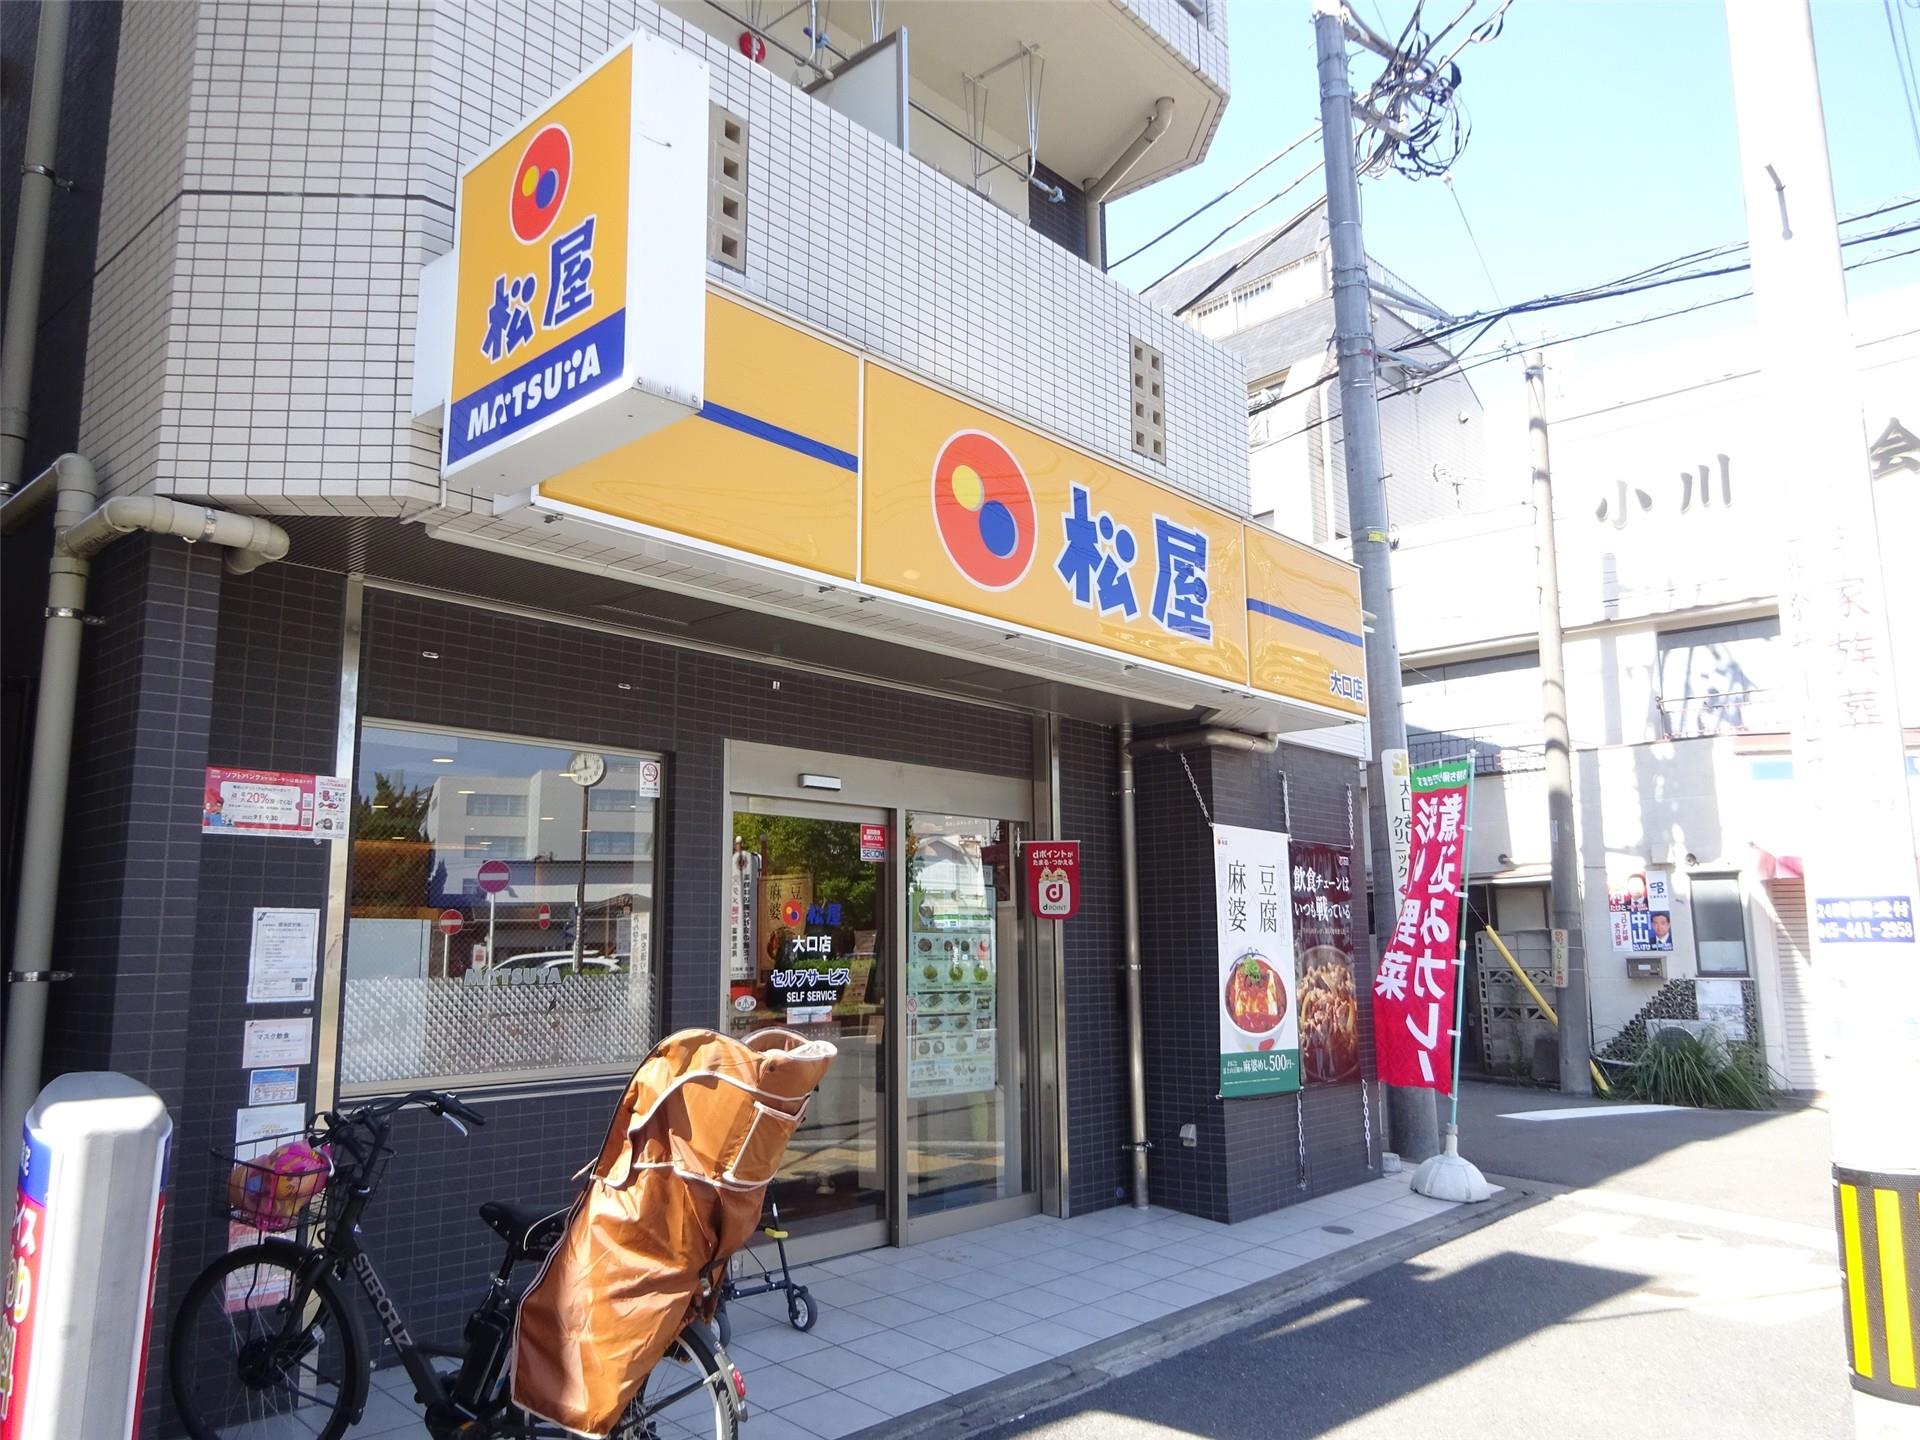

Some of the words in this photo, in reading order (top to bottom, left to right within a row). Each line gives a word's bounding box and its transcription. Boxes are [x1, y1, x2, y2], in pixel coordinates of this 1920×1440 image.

[481, 215, 596, 363] 松屋
[466, 344, 602, 442] MATSUYA
[1596, 453, 1731, 529] 小川
[1054, 482, 1213, 644] 松屋
[1329, 670, 1364, 702] 大口店
[862, 849, 885, 858] SECOM
[1032, 849, 1073, 860] dポイントが
[1393, 815, 1408, 878] クリニック
[1293, 865, 1350, 893] 飲食チェーンは
[1227, 859, 1248, 933] 麻婆
[1258, 863, 1277, 934] 豆腐
[1294, 895, 1351, 922] いつも戦っている
[806, 902, 841, 926] 松屋
[1631, 912, 1649, 944] 中山
[792, 935, 832, 953] 大口店
[463, 967, 562, 986] MATSUYA
[771, 967, 851, 989] セルフサービス
[786, 991, 805, 1003] SELF
[807, 990, 837, 1002] SERVICE
